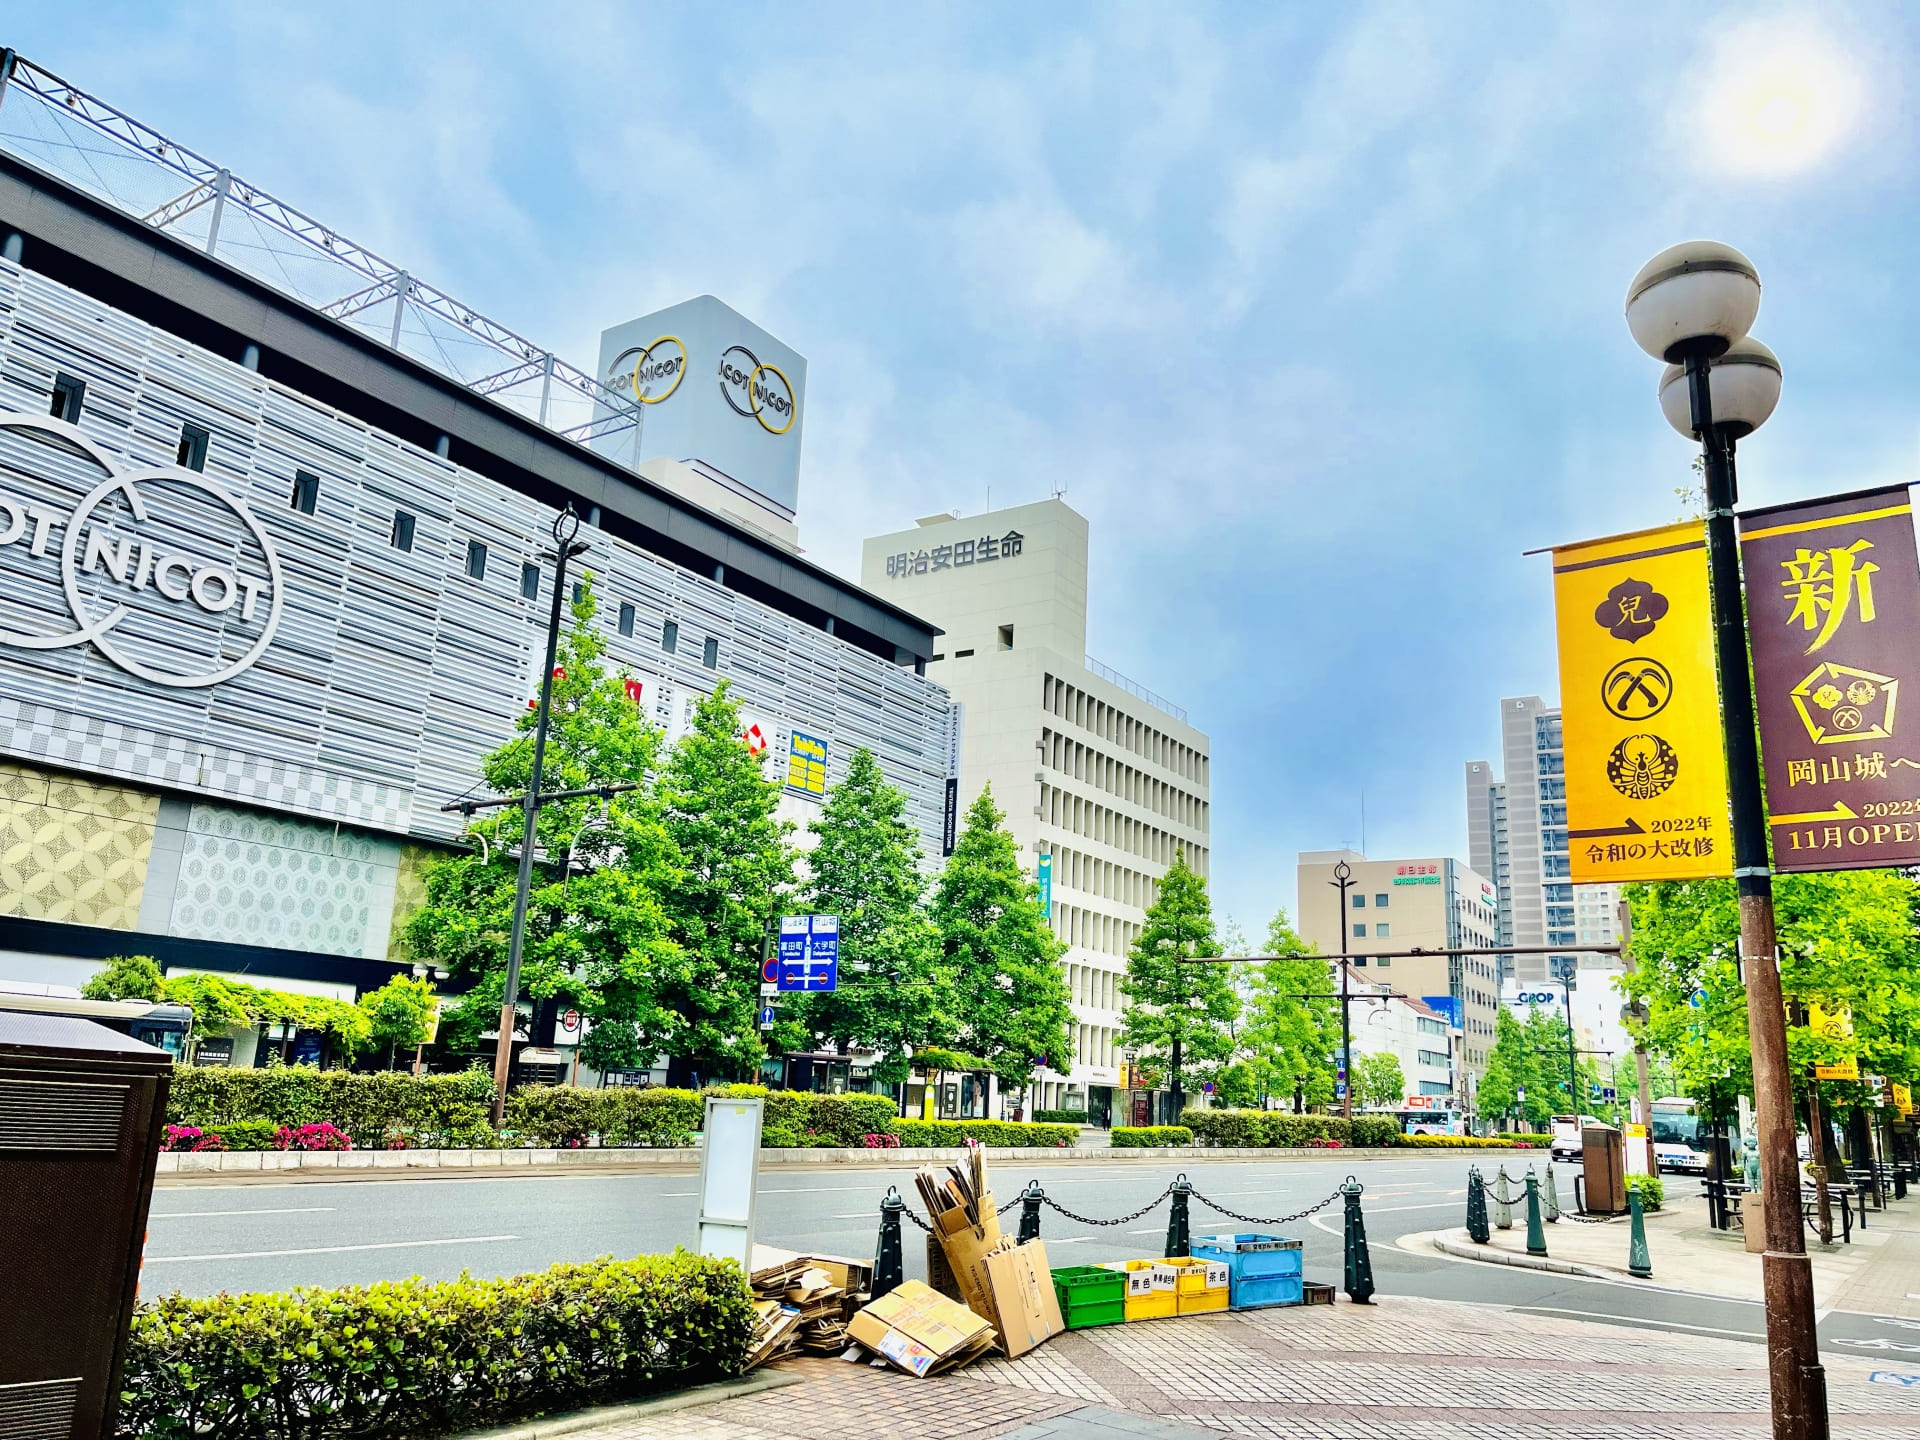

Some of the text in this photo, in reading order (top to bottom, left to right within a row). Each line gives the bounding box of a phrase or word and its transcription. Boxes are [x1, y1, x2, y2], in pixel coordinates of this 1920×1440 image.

[886, 530, 1024, 578] 明治安田生命
[83, 527, 270, 622] NICOT
[1781, 538, 1881, 656] 新
[1787, 752, 1920, 787] 岡山城へ
[1651, 816, 1712, 833] 2022年
[1788, 822, 1920, 850] 11月OPE
[1586, 837, 1714, 863] 令和の大改修
[814, 941, 836, 950] 大学町
[1131, 1278, 1151, 1291] 無色
[1208, 1271, 1227, 1283] 茶色
